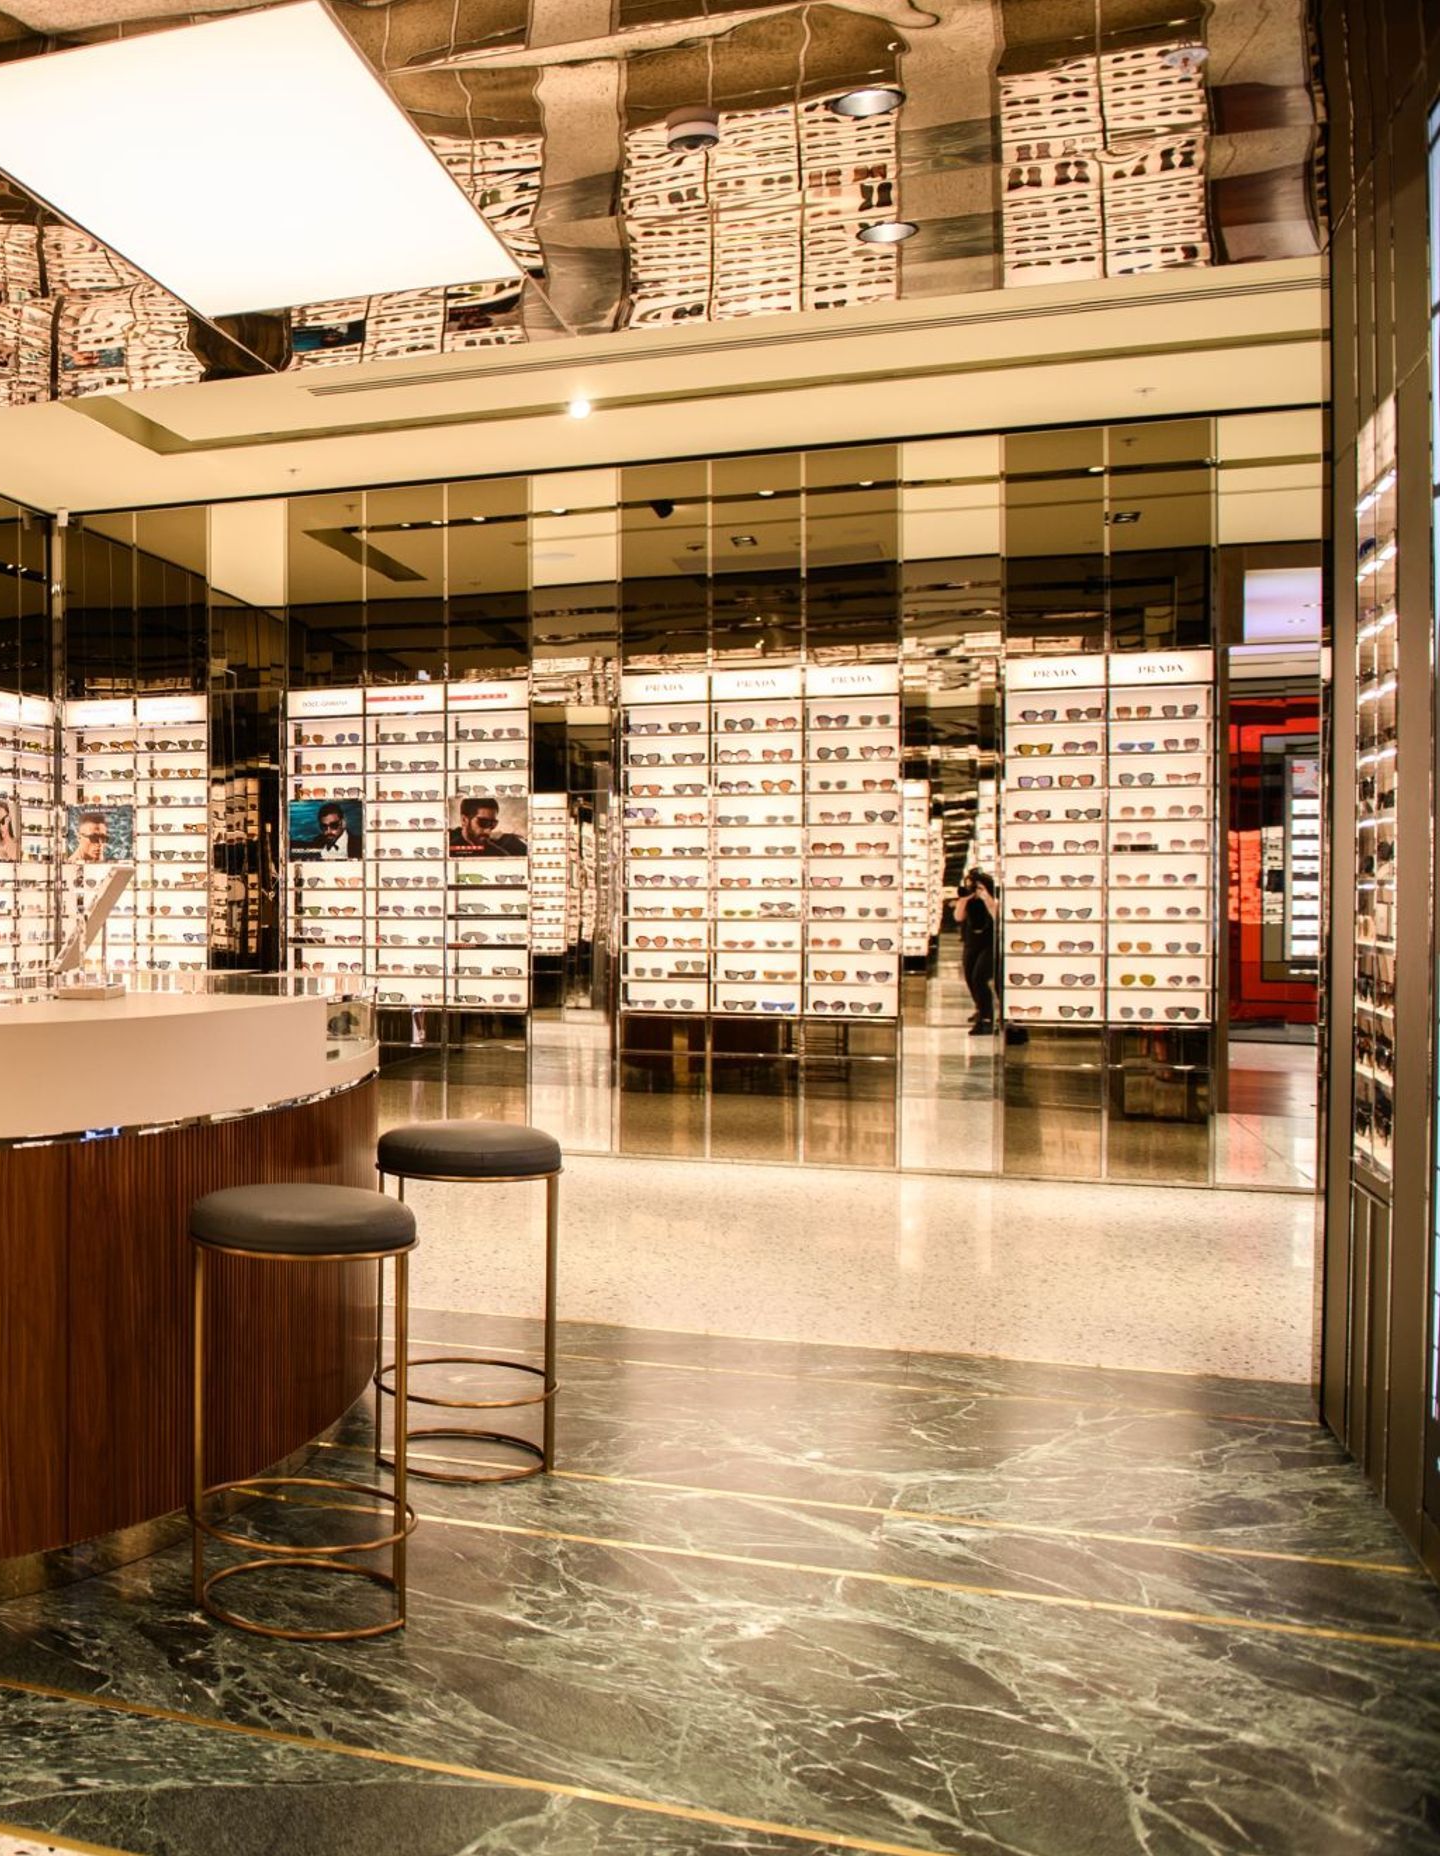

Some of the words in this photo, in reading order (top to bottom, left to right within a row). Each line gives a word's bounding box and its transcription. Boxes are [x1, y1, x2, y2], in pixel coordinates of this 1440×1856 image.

[1138, 664, 1185, 674] PRADA
[1033, 669, 1078, 679] PRADA
[736, 679, 777, 688] PRADA
[831, 675, 873, 684] PRADA
[644, 683, 684, 692] PRADA
